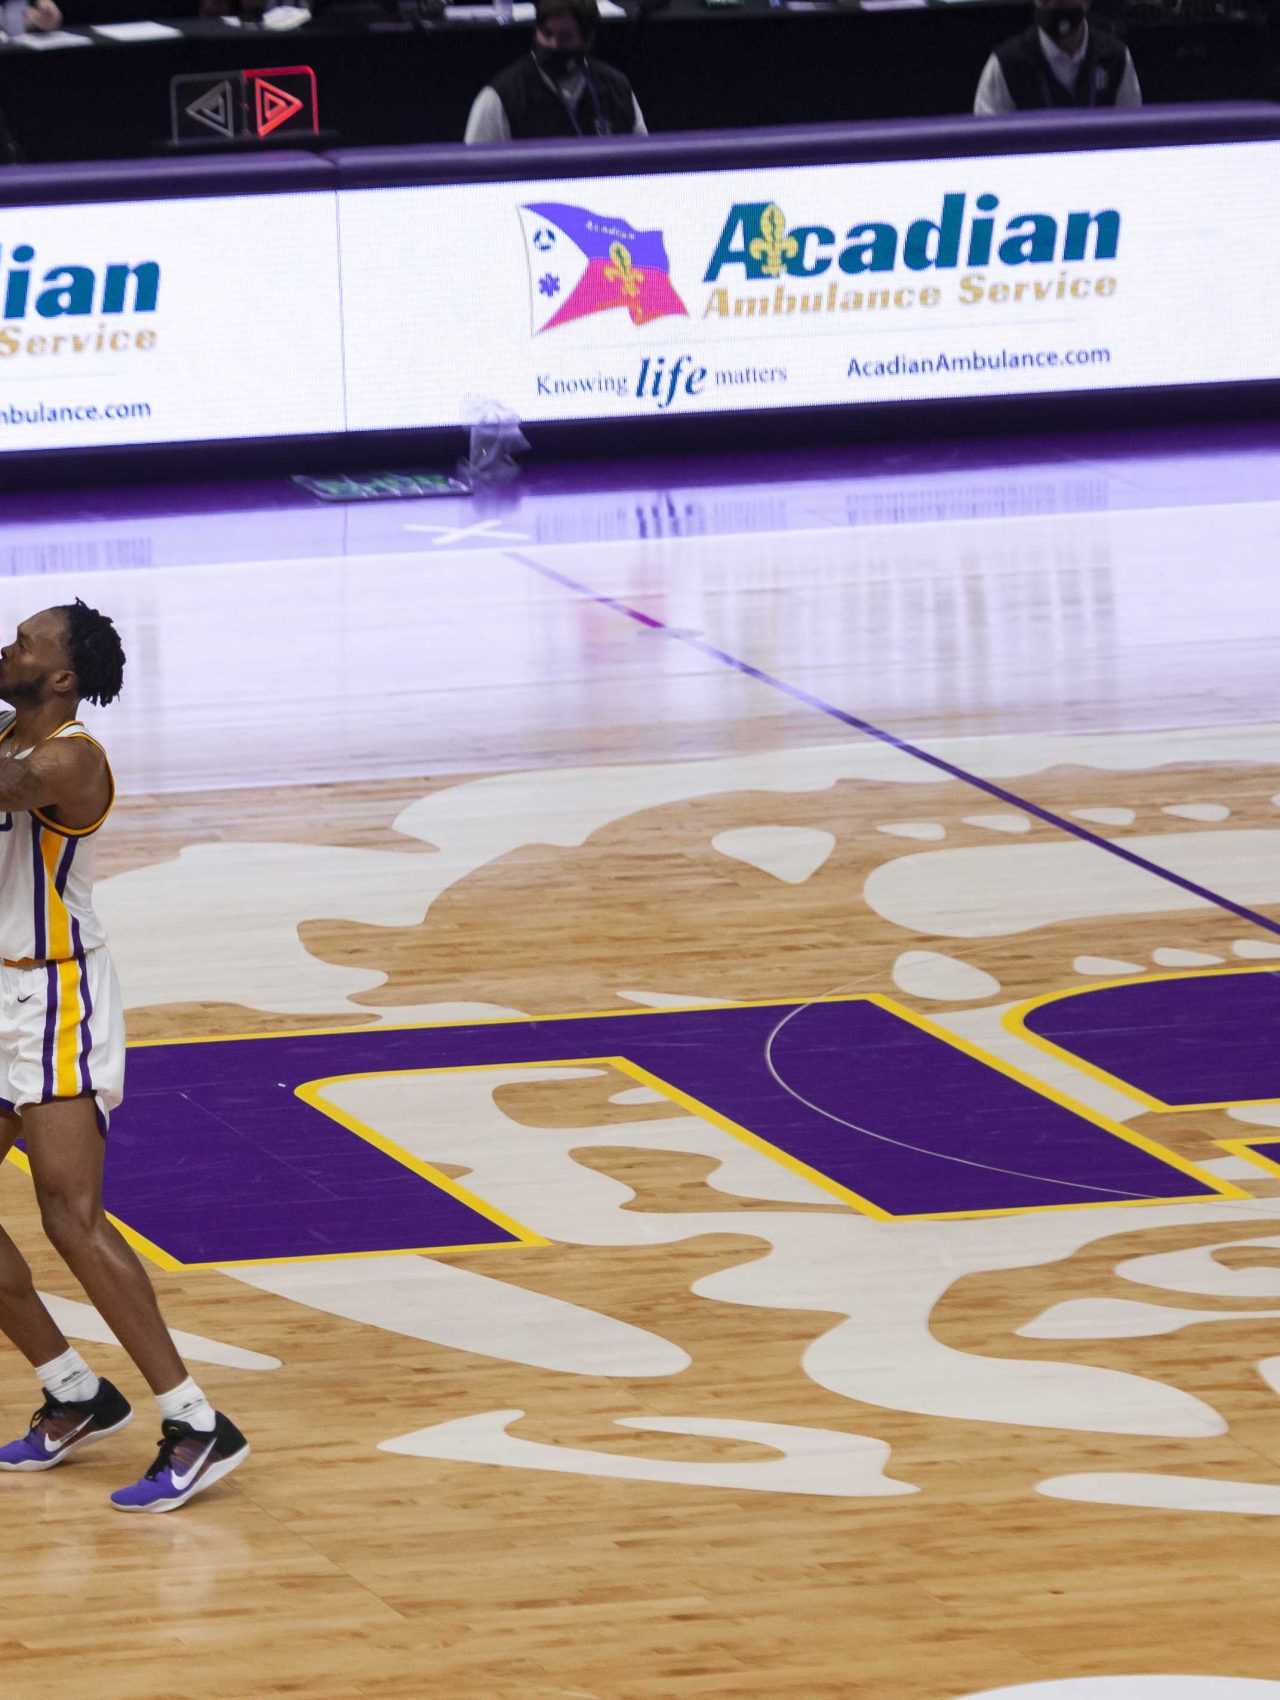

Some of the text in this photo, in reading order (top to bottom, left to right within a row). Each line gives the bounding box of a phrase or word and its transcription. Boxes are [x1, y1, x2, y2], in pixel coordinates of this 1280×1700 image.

[703, 192, 1121, 283] Acadian
[703, 271, 1118, 320] Ambulance Service
[536, 355, 788, 408] Knowing life matters
[847, 347, 1111, 379] AcadianAmbulance.com
